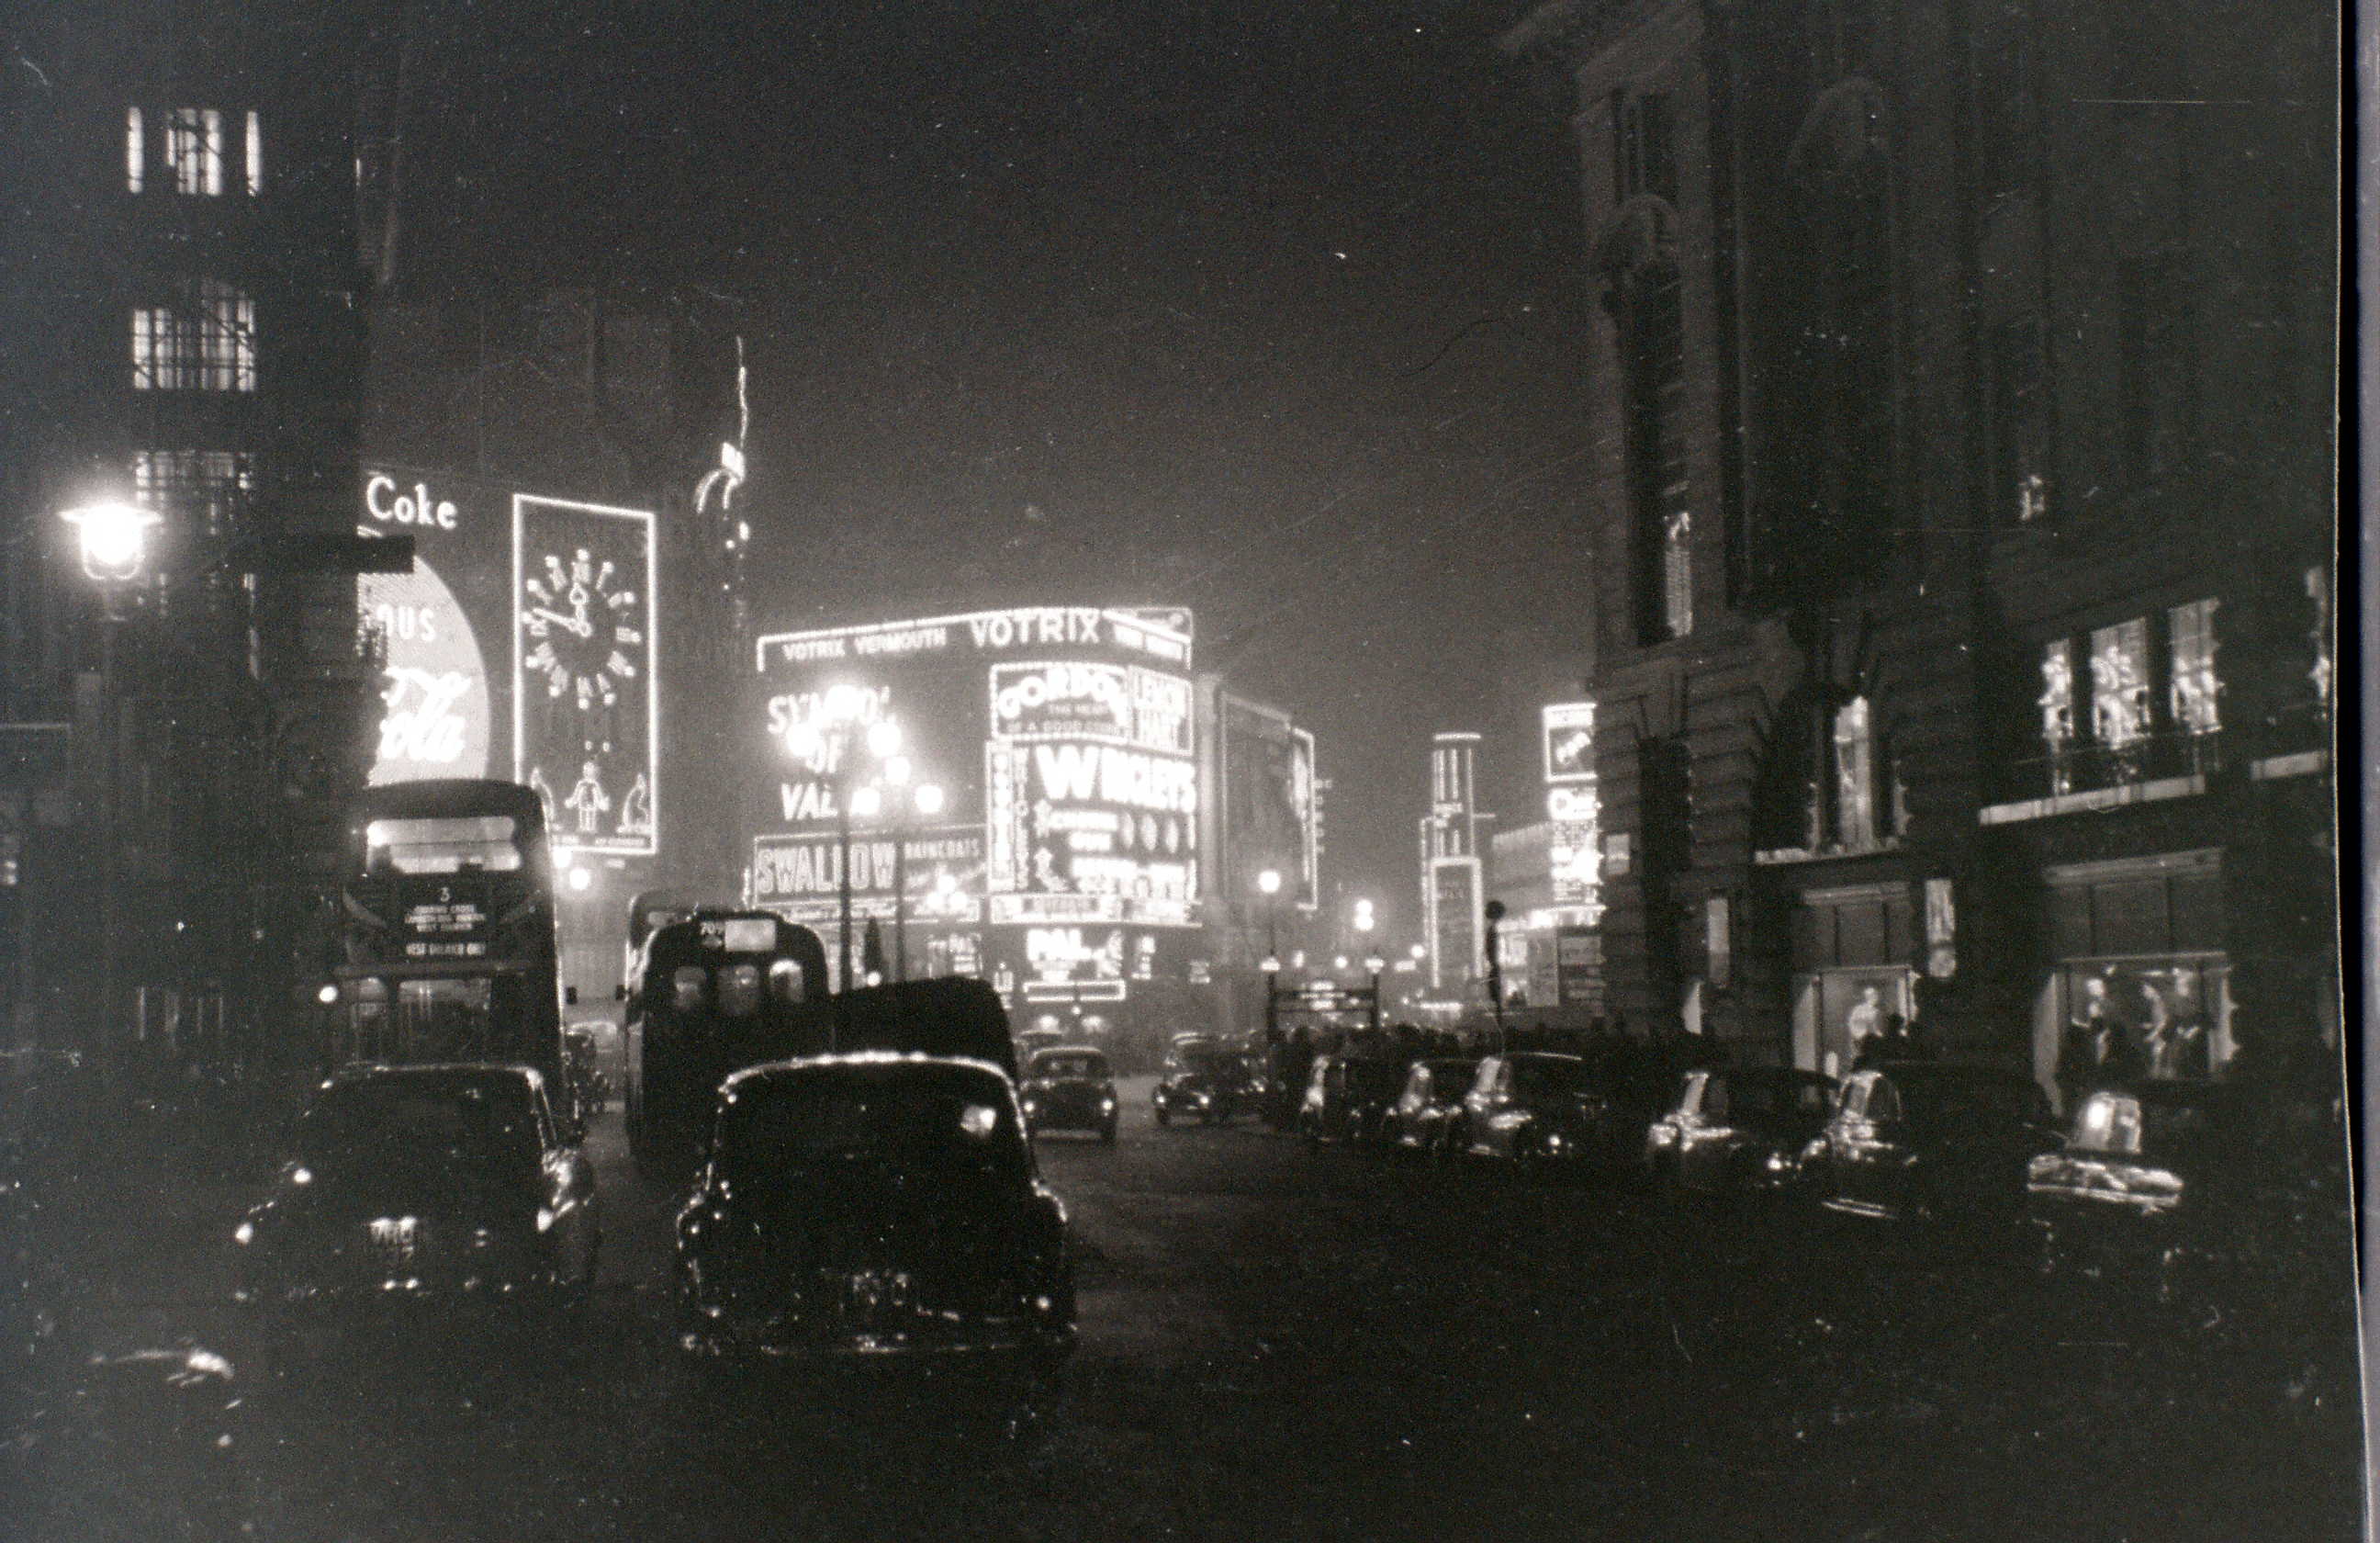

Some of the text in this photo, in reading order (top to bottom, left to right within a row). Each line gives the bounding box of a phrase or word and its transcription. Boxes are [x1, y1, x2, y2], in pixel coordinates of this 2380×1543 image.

[367, 476, 456, 528] Coke
[783, 626, 947, 661] VOTRIX VERMOUTH
[969, 613, 1101, 648] VOTRIX
